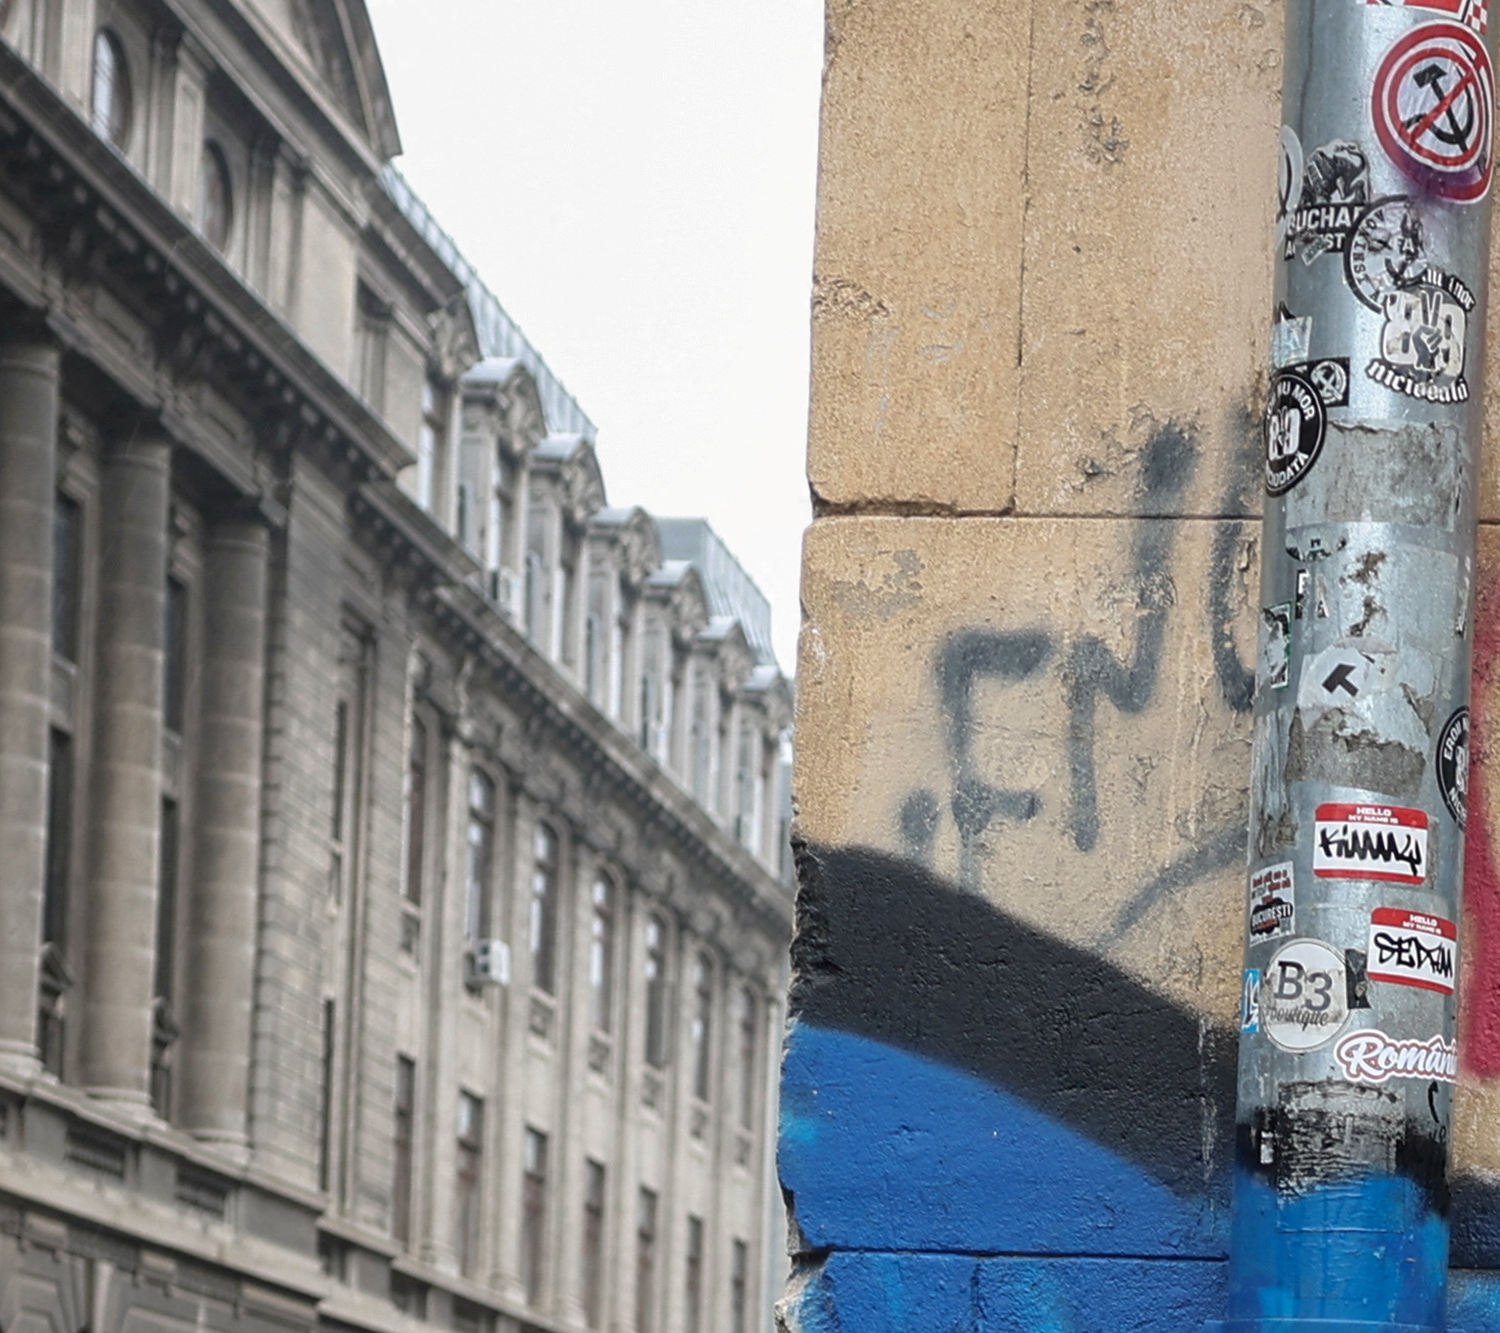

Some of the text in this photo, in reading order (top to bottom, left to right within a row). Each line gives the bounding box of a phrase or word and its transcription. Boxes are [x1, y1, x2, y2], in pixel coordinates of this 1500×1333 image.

[1291, 384, 1315, 421] MOR
[1356, 806, 1392, 817] HELLO
[1410, 914, 1437, 927] HELLO
[1274, 960, 1332, 1011] B3
[1340, 1034, 1457, 1075] Români
